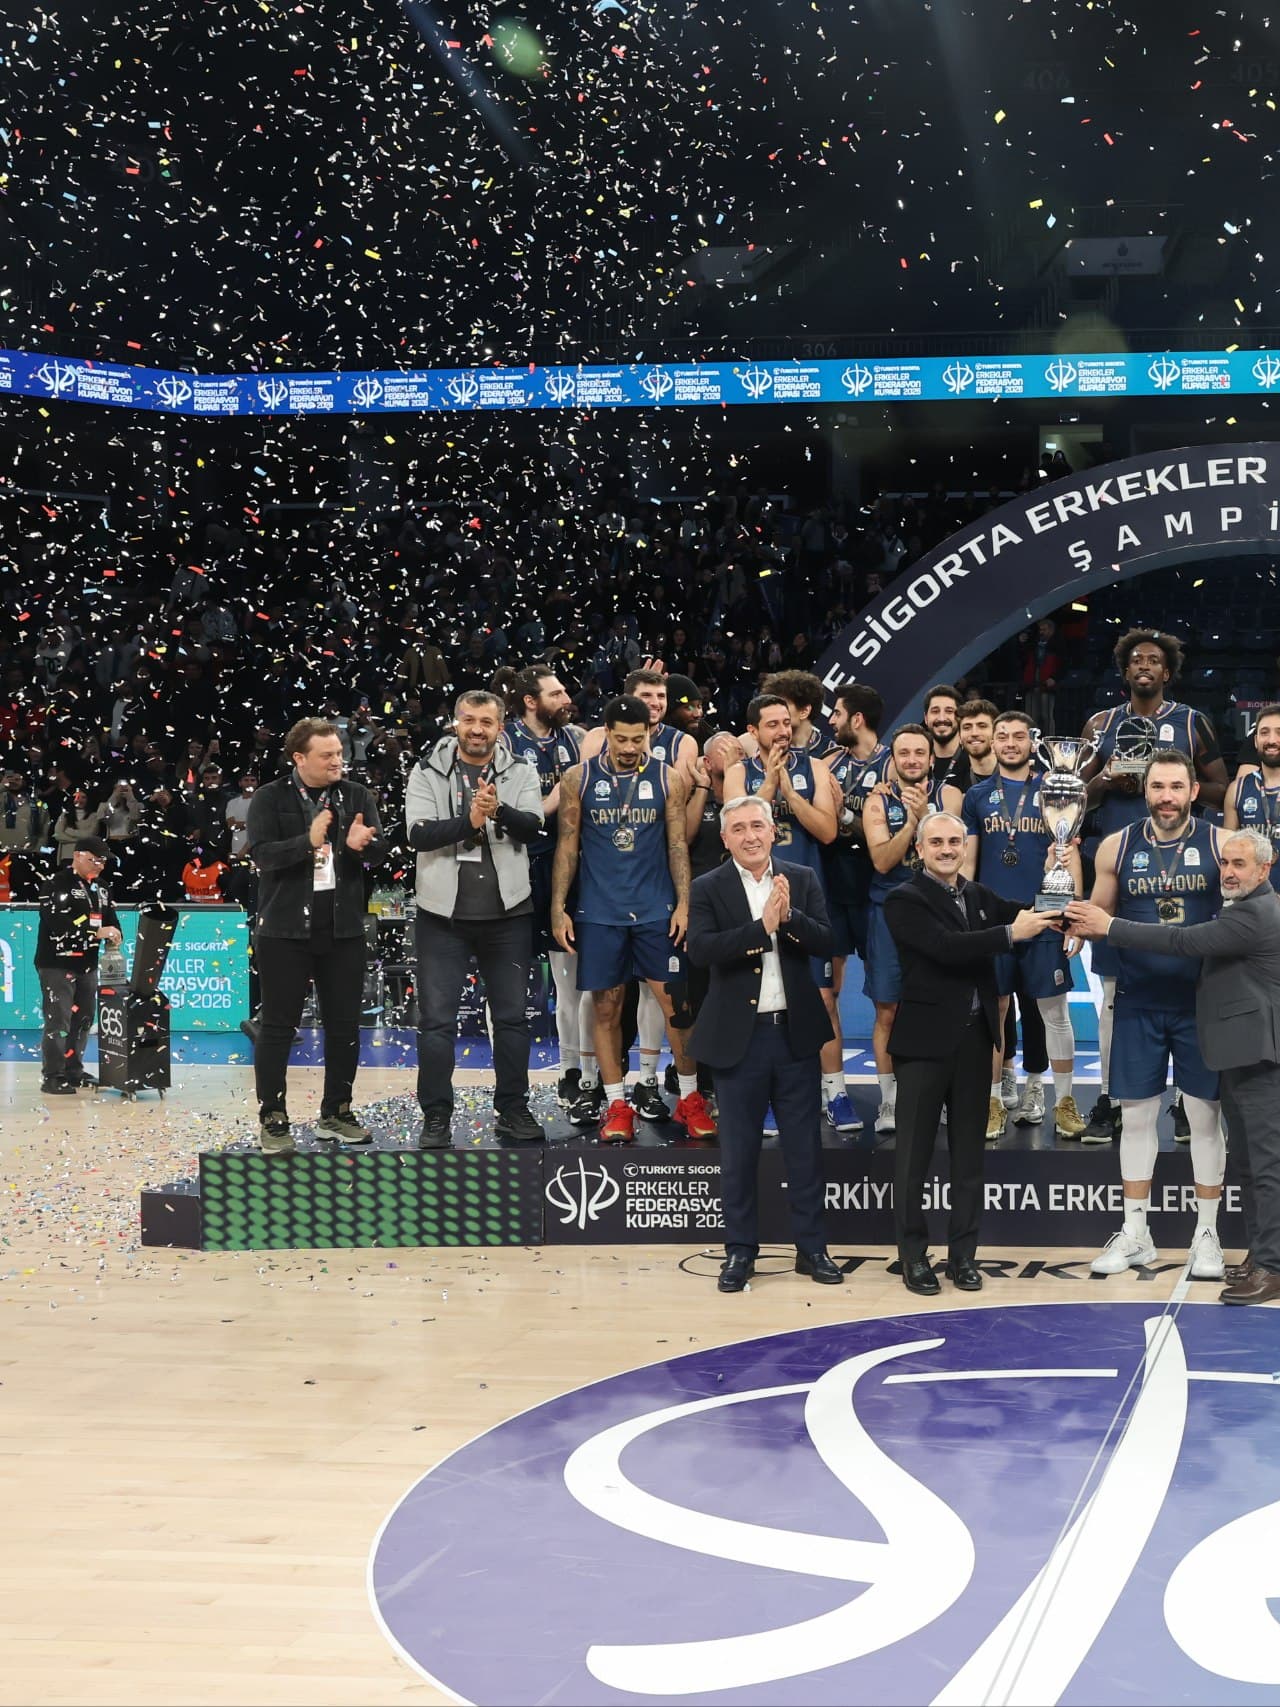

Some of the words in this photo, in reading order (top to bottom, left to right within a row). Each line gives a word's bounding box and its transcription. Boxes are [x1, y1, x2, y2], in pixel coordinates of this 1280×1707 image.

[849, 523, 1023, 666] SİGORTA
[1024, 457, 1267, 535] ERKEKLER
[192, 994, 232, 1009] 2026
[626, 1181, 709, 1196] ERKEKLER
[626, 1198, 722, 1212] FEDERASYO
[1049, 1184, 1197, 1212] ERKELER
[626, 1213, 689, 1228] KUPASI
[695, 1213, 726, 1228] 202
